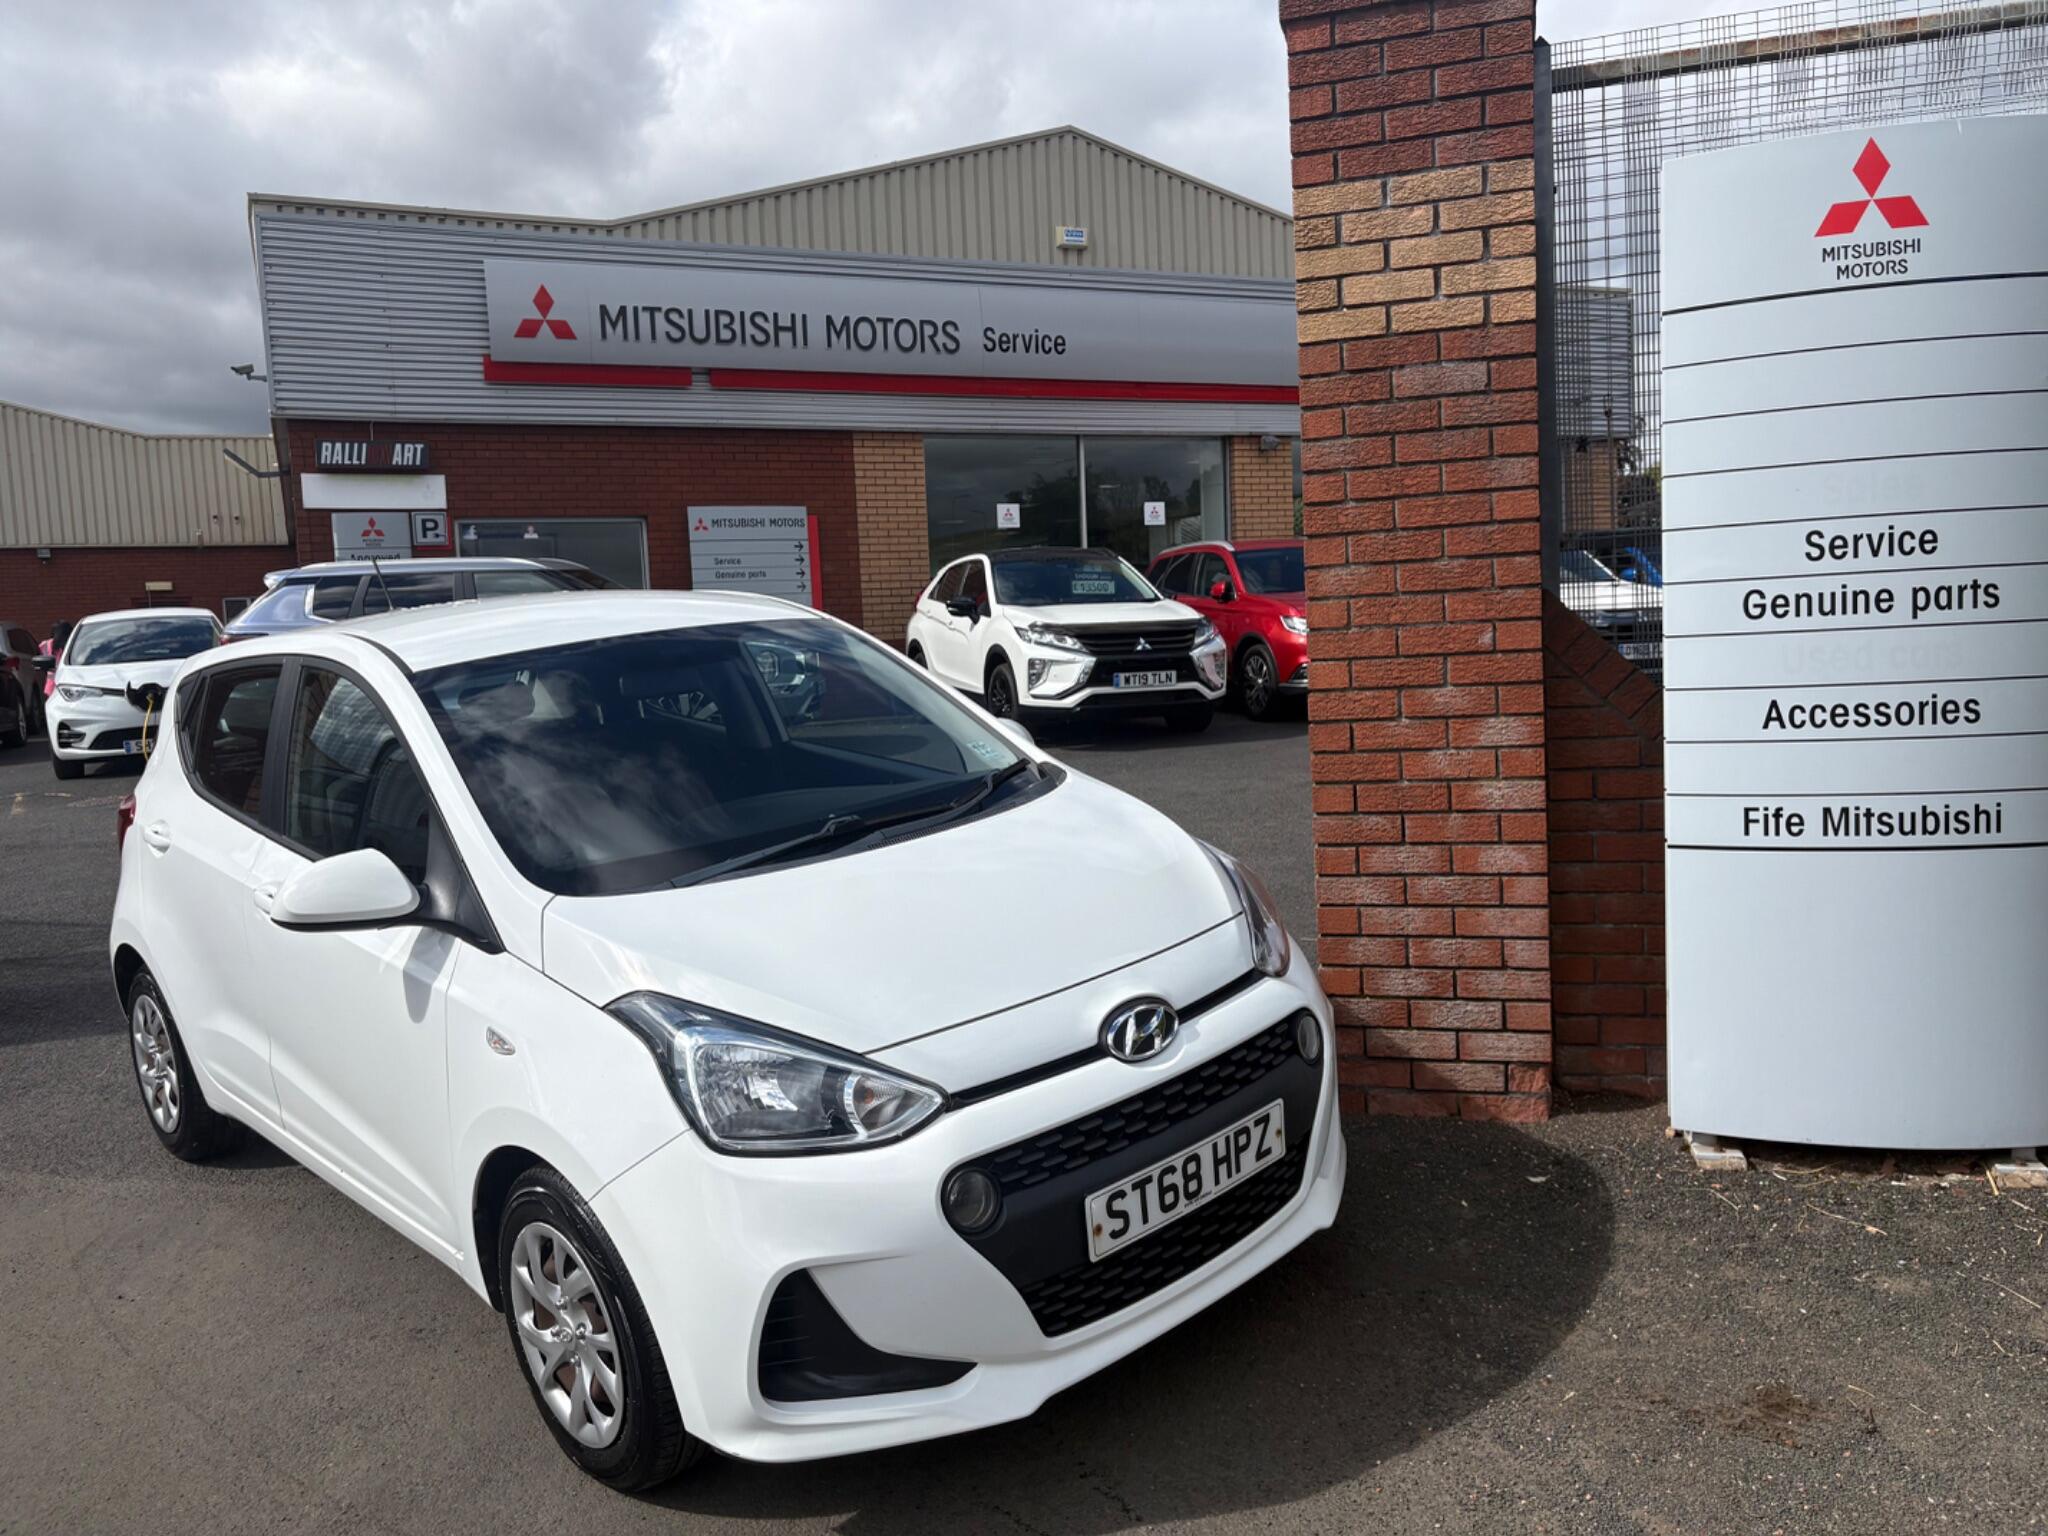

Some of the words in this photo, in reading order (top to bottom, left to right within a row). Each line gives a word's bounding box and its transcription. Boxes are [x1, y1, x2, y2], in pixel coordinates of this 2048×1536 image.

[1821, 238, 1922, 263] MITSUBISHI
[1836, 259, 1909, 281] MOTORS
[599, 304, 809, 350] MITSUBISHI
[825, 314, 961, 355] MOTORS
[983, 326, 1067, 356] Service
[421, 518, 439, 539] P
[712, 518, 765, 529] MITSUBISHI
[769, 517, 806, 528] MOTORS
[1804, 525, 1939, 562] Service
[714, 557, 742, 566] Service
[715, 571, 746, 579] Genuine
[1742, 584, 1895, 620] Genuine
[1910, 579, 2001, 620] parts
[1152, 672, 1173, 684] TLN
[1762, 694, 1981, 730] Accessories
[1743, 807, 1805, 837] Fife
[1822, 802, 2002, 837] Mitsubishi
[1105, 1152, 1203, 1240] ST68
[1211, 1112, 1273, 1187] HPZ
